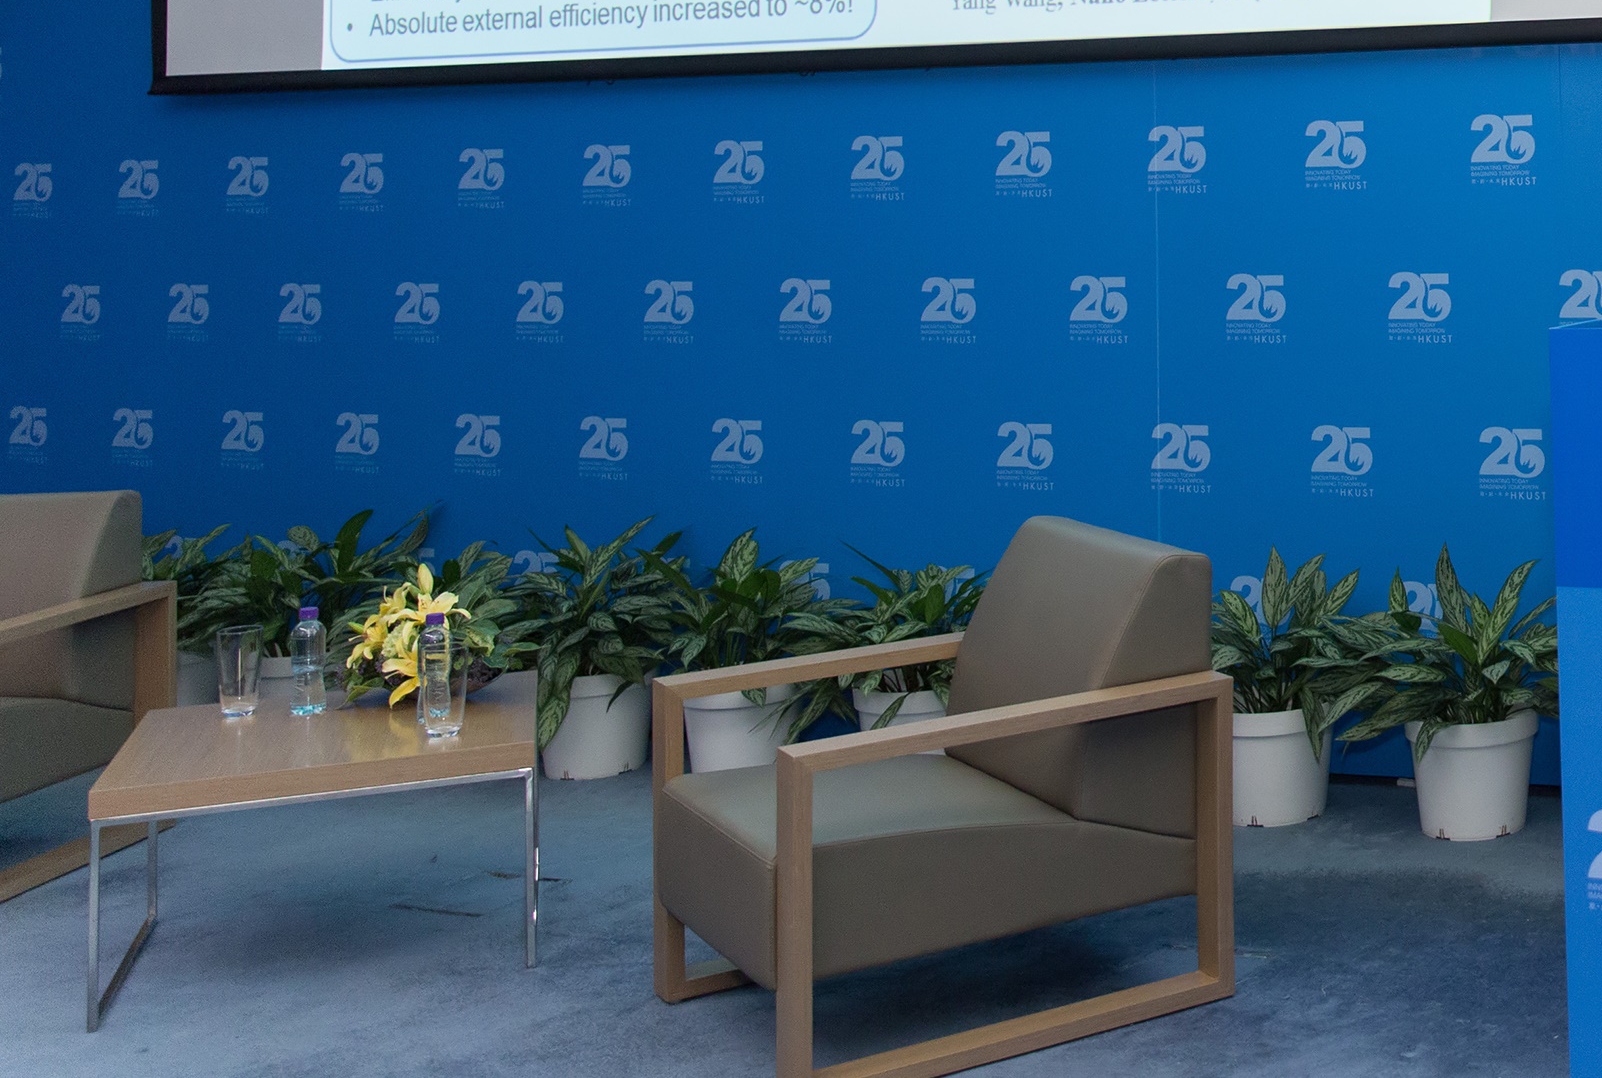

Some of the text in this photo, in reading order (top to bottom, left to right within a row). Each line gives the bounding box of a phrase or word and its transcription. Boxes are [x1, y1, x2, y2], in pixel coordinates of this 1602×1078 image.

[368, 10, 459, 37] Absolute
[460, 4, 544, 33] external
[547, 2, 649, 30] efficiency
[1403, 125, 1430, 147] 25
[458, 148, 505, 191] 25
[996, 130, 1052, 178] 25
[1021, 188, 1053, 198] HKUST
[1302, 193, 1327, 215] 25
[61, 284, 101, 324] 25
[779, 278, 832, 324] 25
[803, 335, 832, 344] HKUST
